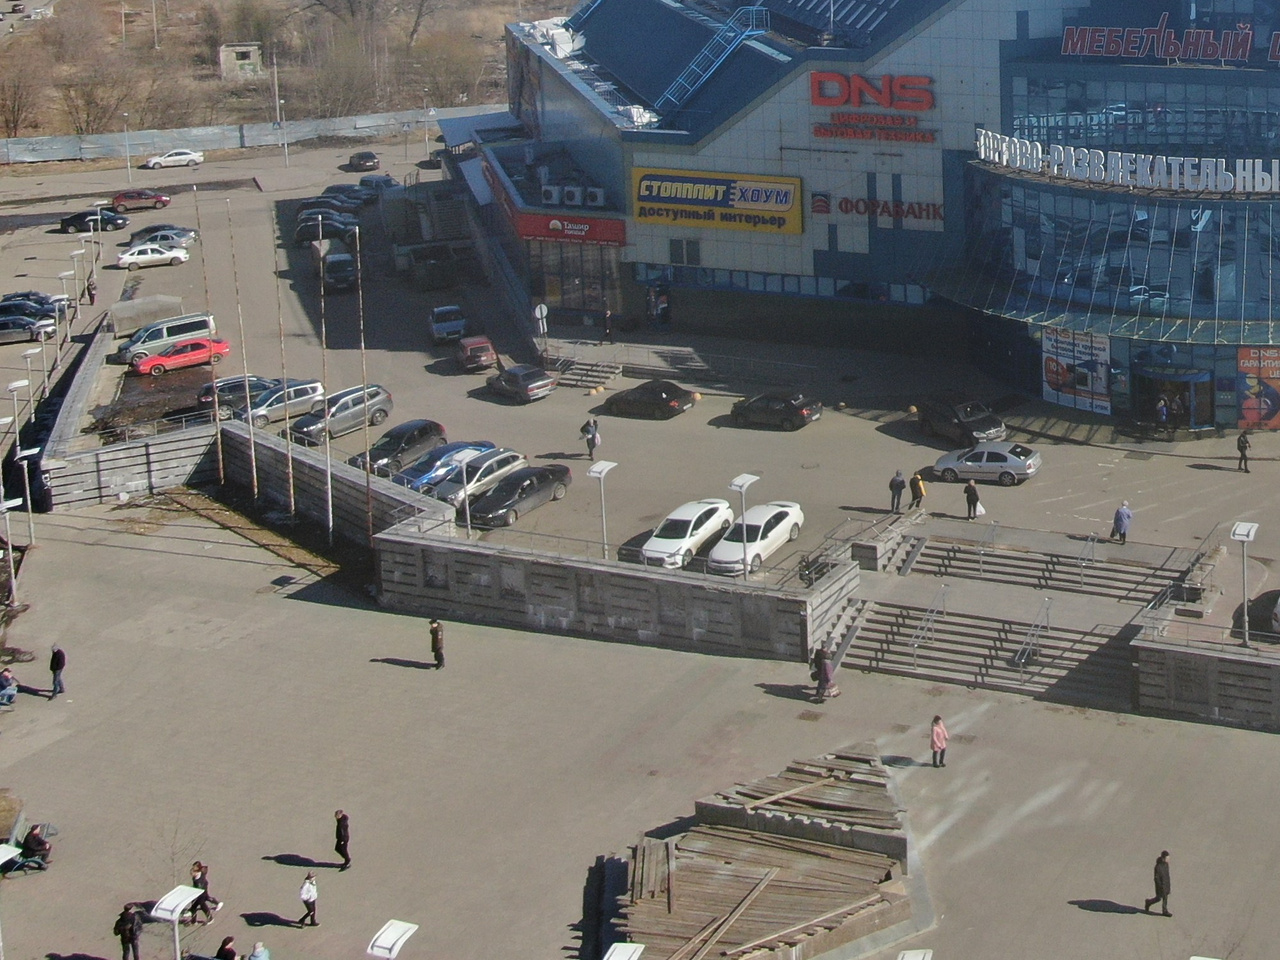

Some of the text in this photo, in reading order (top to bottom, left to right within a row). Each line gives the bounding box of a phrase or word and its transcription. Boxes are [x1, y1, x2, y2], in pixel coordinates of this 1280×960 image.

[1060, 12, 1253, 61] МЕБЕЛЬНЫЙ
[810, 71, 936, 112] DNS
[738, 186, 790, 205] ХОУМ
[838, 197, 945, 221] ФОРАБАНК
[562, 221, 590, 232] Ташир
[719, 211, 786, 229] интерьер
[1250, 349, 1278, 357] DNS
